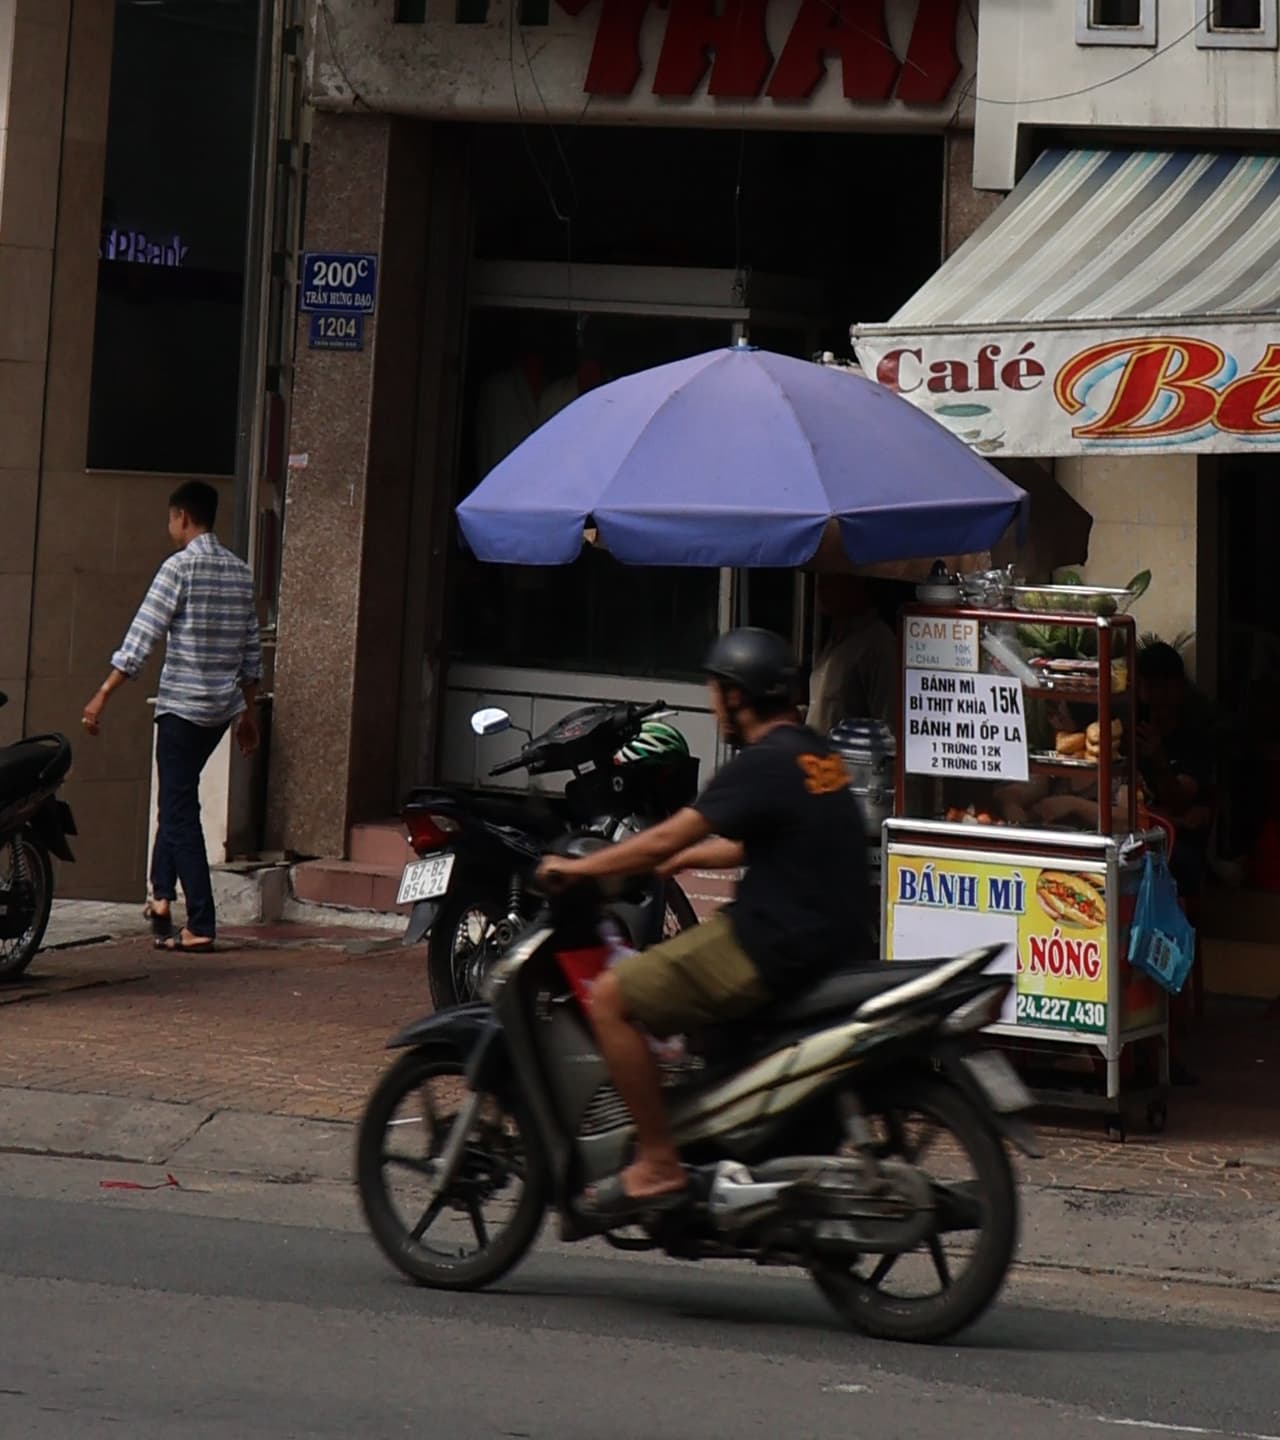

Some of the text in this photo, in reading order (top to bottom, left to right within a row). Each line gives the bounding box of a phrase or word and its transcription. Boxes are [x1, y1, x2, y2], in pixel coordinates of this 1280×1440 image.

[318, 317, 357, 337] 1204
[877, 341, 1046, 393] Café
[910, 621, 973, 641] CAM ÉP
[921, 674, 976, 695] BÁNH MÌ
[927, 697, 954, 716] THỊT
[990, 685, 1021, 715] 15K
[910, 716, 1022, 743] BÁNH MÌ ỐP LA
[932, 742, 937, 753] 1
[982, 745, 1002, 758] 12K
[931, 757, 939, 769] 2
[982, 761, 1002, 773] 15K
[899, 864, 1025, 912] BÁNH MÌ
[1030, 928, 1100, 979] NÓNG
